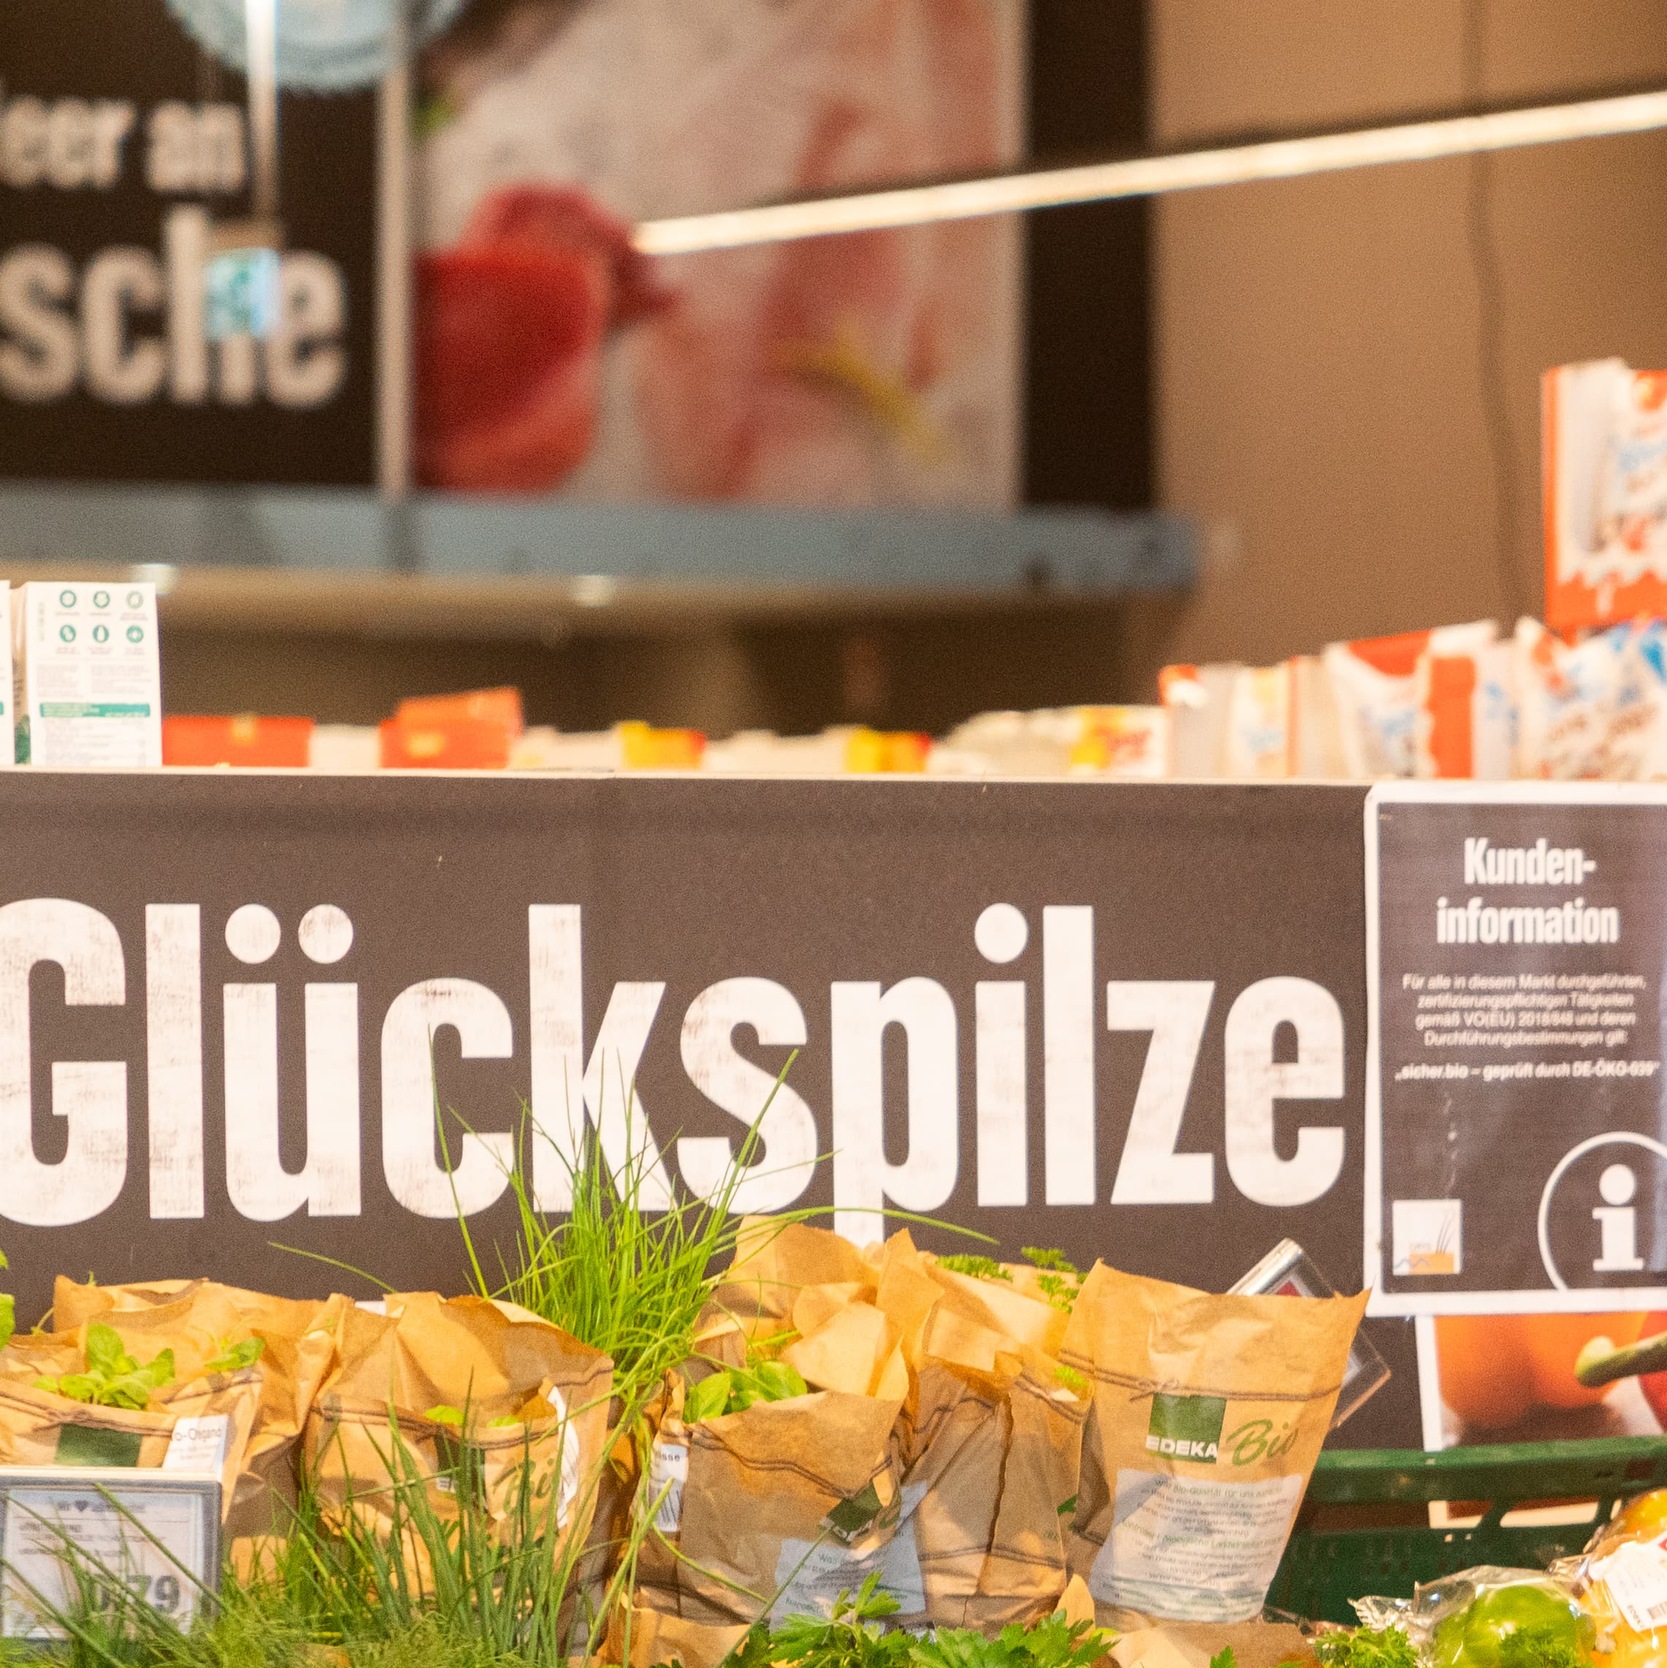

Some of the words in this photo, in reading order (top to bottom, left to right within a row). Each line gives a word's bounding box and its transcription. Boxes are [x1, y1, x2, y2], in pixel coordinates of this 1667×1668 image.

[146, 103, 247, 194] an
[0, 204, 349, 408] sche
[1463, 837, 1597, 886] Kunden-
[1436, 896, 1620, 945] information
[0, 896, 1346, 1242] Glückspilze
[1145, 1434, 1219, 1459] EDEKA
[1225, 1418, 1300, 1466] Bio
